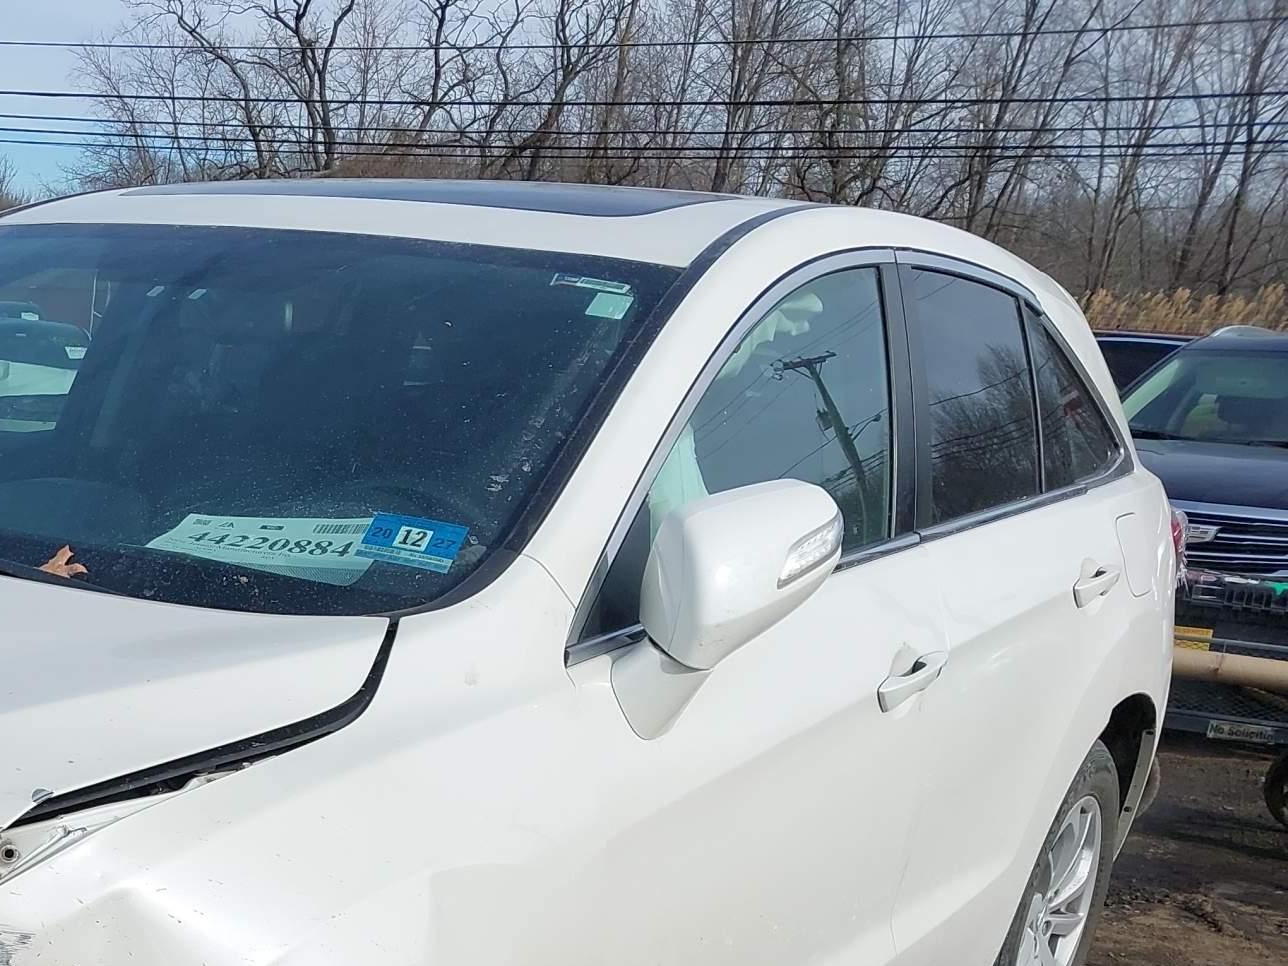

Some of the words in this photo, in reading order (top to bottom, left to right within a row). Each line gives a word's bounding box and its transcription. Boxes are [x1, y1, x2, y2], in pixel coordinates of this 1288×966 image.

[188, 530, 354, 557] 44220884
[371, 526, 394, 539] 20
[398, 528, 428, 548] 12
[431, 537, 457, 550] 27
[1209, 723, 1225, 735] No
